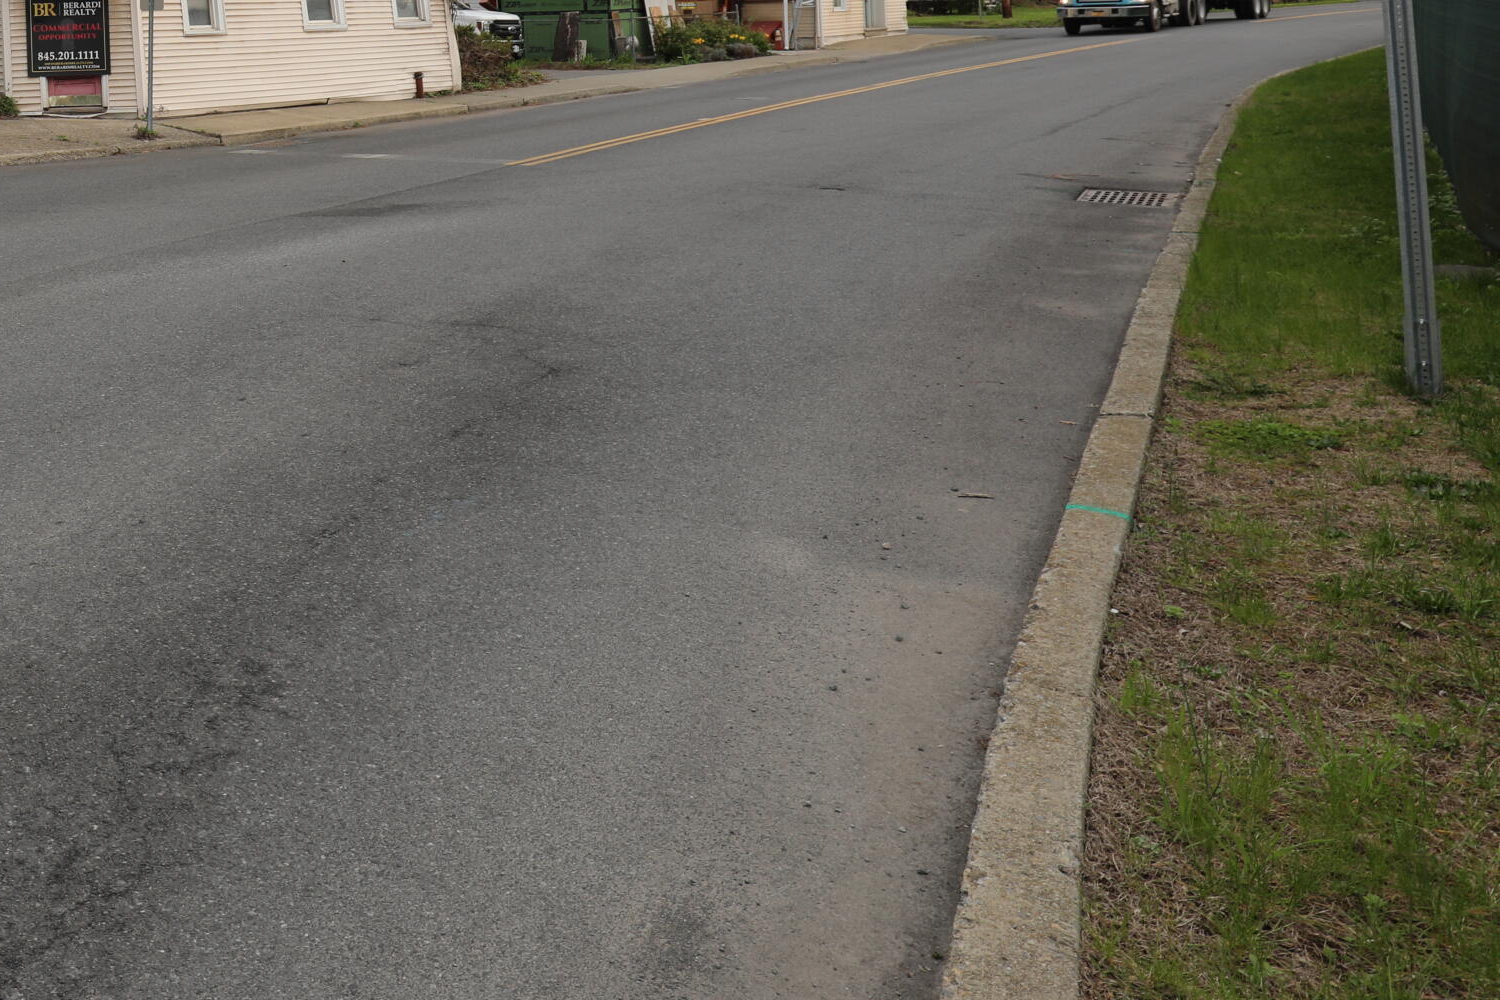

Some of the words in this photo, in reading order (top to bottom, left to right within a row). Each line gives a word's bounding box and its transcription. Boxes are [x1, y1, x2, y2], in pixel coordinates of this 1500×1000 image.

[32, 2, 57, 17] BR
[63, 1, 101, 9] BERARDI
[63, 8, 96, 16] REALTY
[33, 23, 102, 32] COMMERCIAL
[38, 33, 97, 41] OPPORTUNITY
[37, 50, 100, 61] 845.201.1111
